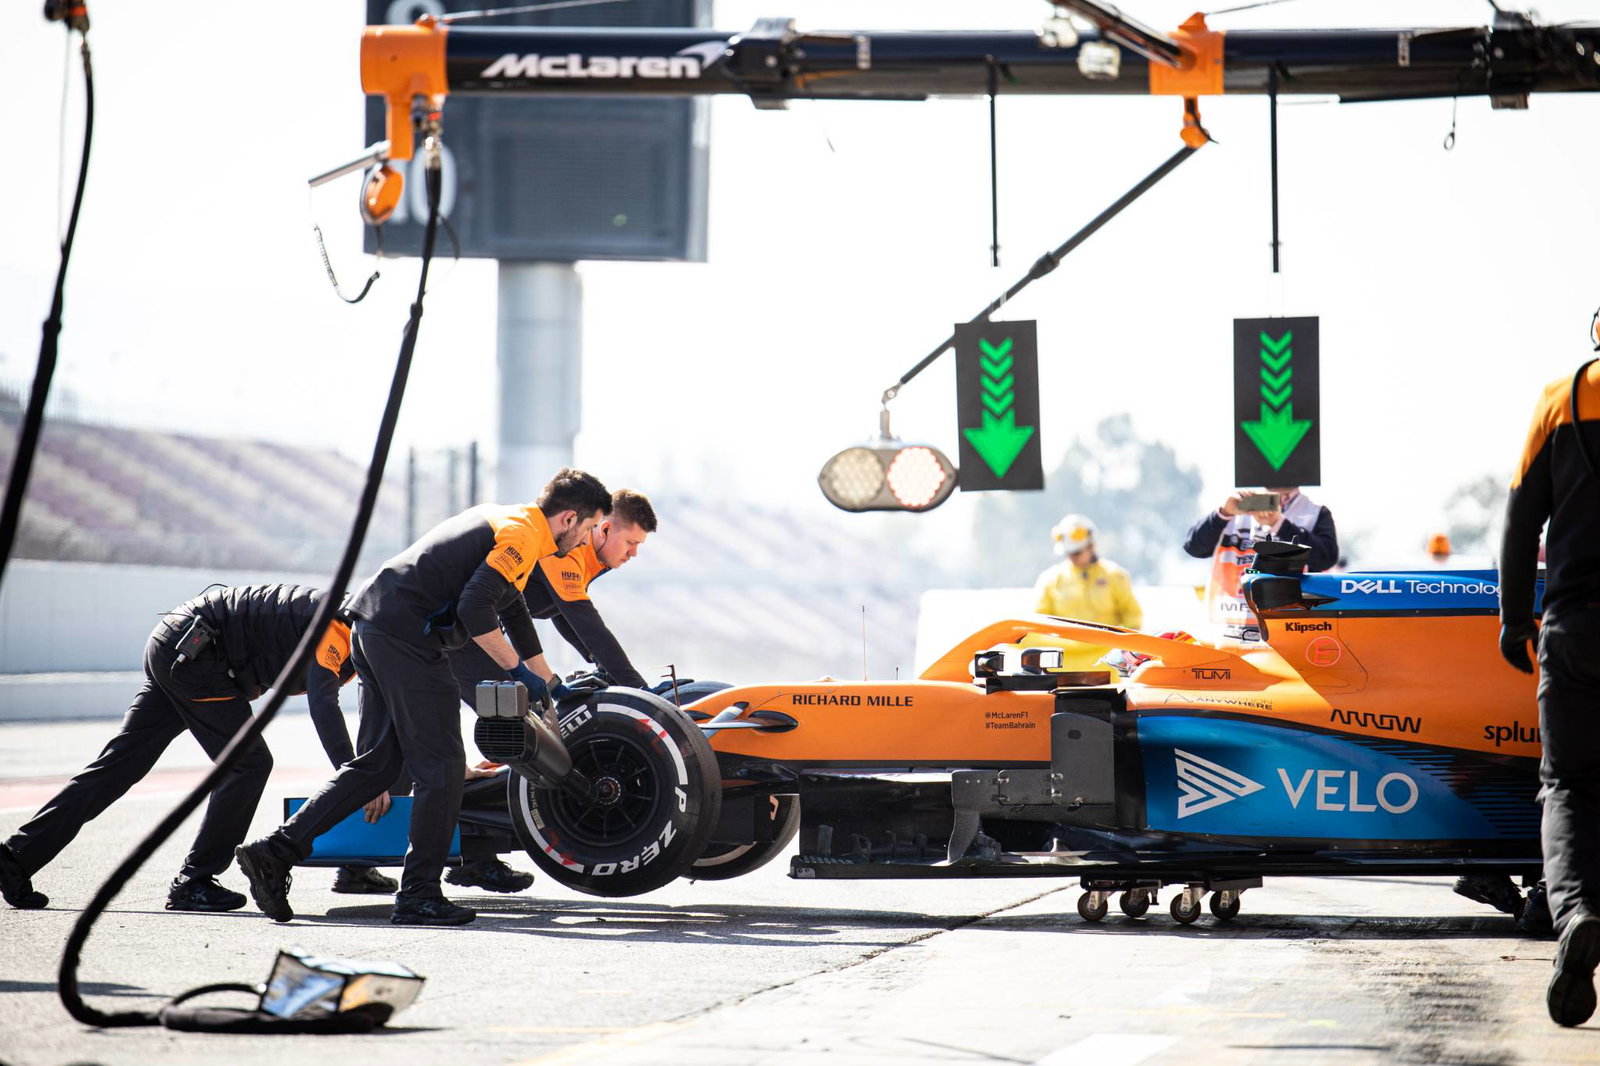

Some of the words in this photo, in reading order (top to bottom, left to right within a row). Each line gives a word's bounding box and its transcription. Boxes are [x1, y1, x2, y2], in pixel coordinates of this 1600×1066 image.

[481, 53, 701, 78] McLaren
[1341, 579, 1402, 595] DELL
[1285, 622, 1332, 633] Klipsch
[1191, 668, 1231, 680] TUMI
[792, 694, 861, 706] RICHARD
[866, 695, 914, 707] MILLE
[985, 721, 1036, 730] #TeamBahrain
[1330, 708, 1422, 734] ARROW
[675, 786, 687, 813] P
[1277, 768, 1419, 814] VELO
[591, 820, 677, 876] ZERO
